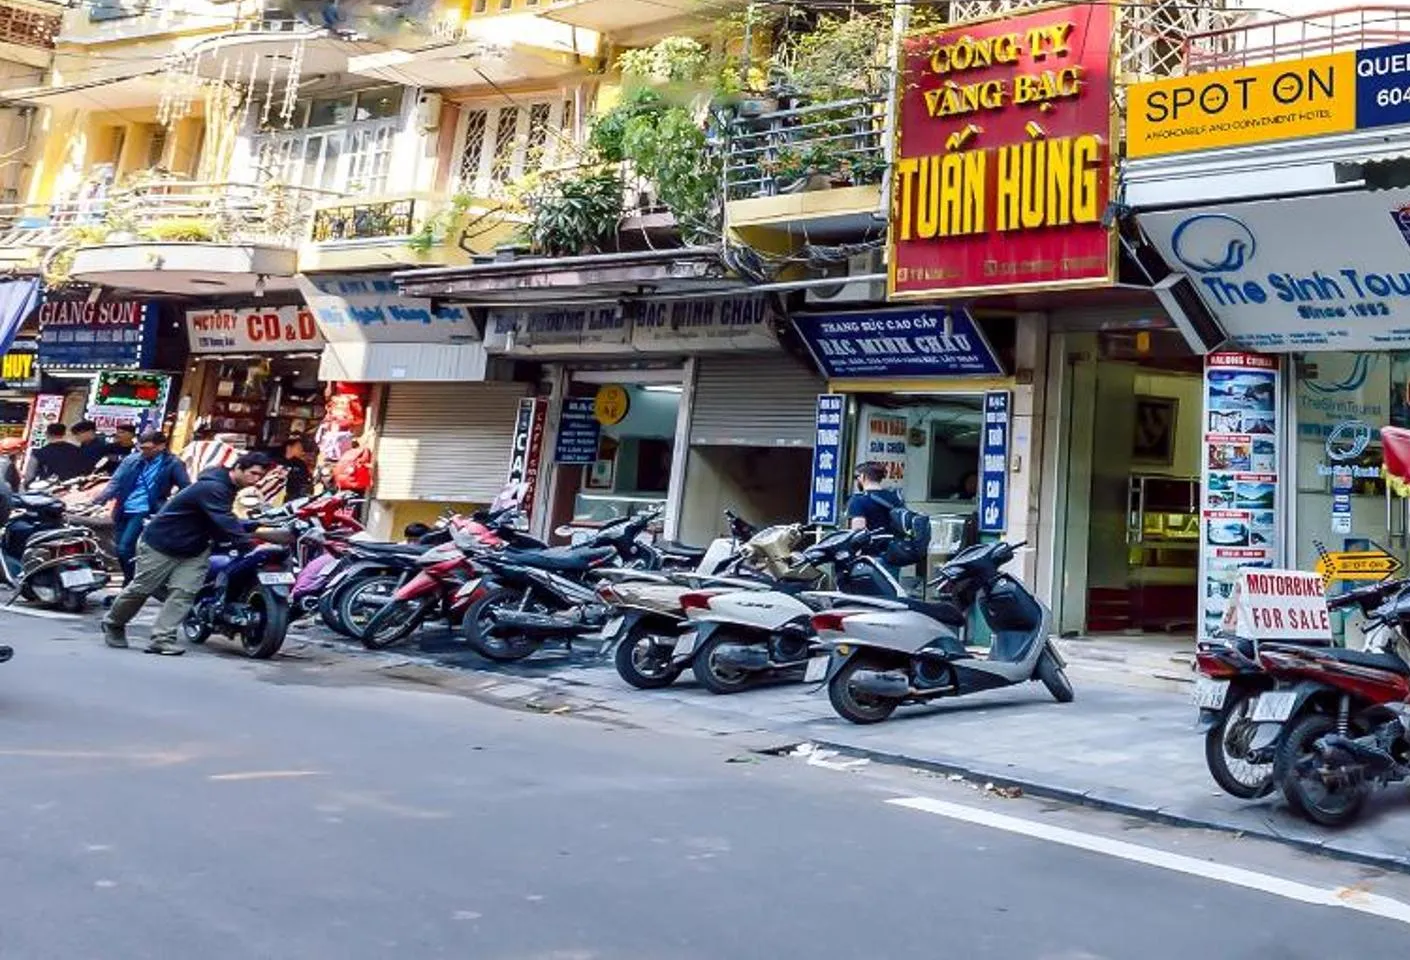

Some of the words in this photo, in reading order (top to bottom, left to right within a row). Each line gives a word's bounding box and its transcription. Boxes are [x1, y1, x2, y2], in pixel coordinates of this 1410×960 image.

[930, 32, 1020, 75] CÔNG
[1028, 22, 1075, 61] TY
[924, 80, 1004, 118] VÀNG
[1013, 67, 1084, 113] BẠC
[1146, 77, 1257, 123] SPOT
[1272, 66, 1335, 105] ON
[898, 122, 988, 241] TUẤN
[996, 120, 1101, 233] HÙNG
[1201, 274, 1267, 307] The
[1268, 270, 1346, 303] Sinh
[38, 301, 95, 325] GIANG
[886, 318, 912, 331] CAO
[1296, 304, 1347, 320] Since
[246, 313, 281, 341] CD
[285, 323, 296, 341] &
[2, 353, 33, 379] HUY
[1246, 573, 1324, 596] MOTORBIKE
[1252, 607, 1284, 629] FOR
[1289, 607, 1330, 630] SALE
